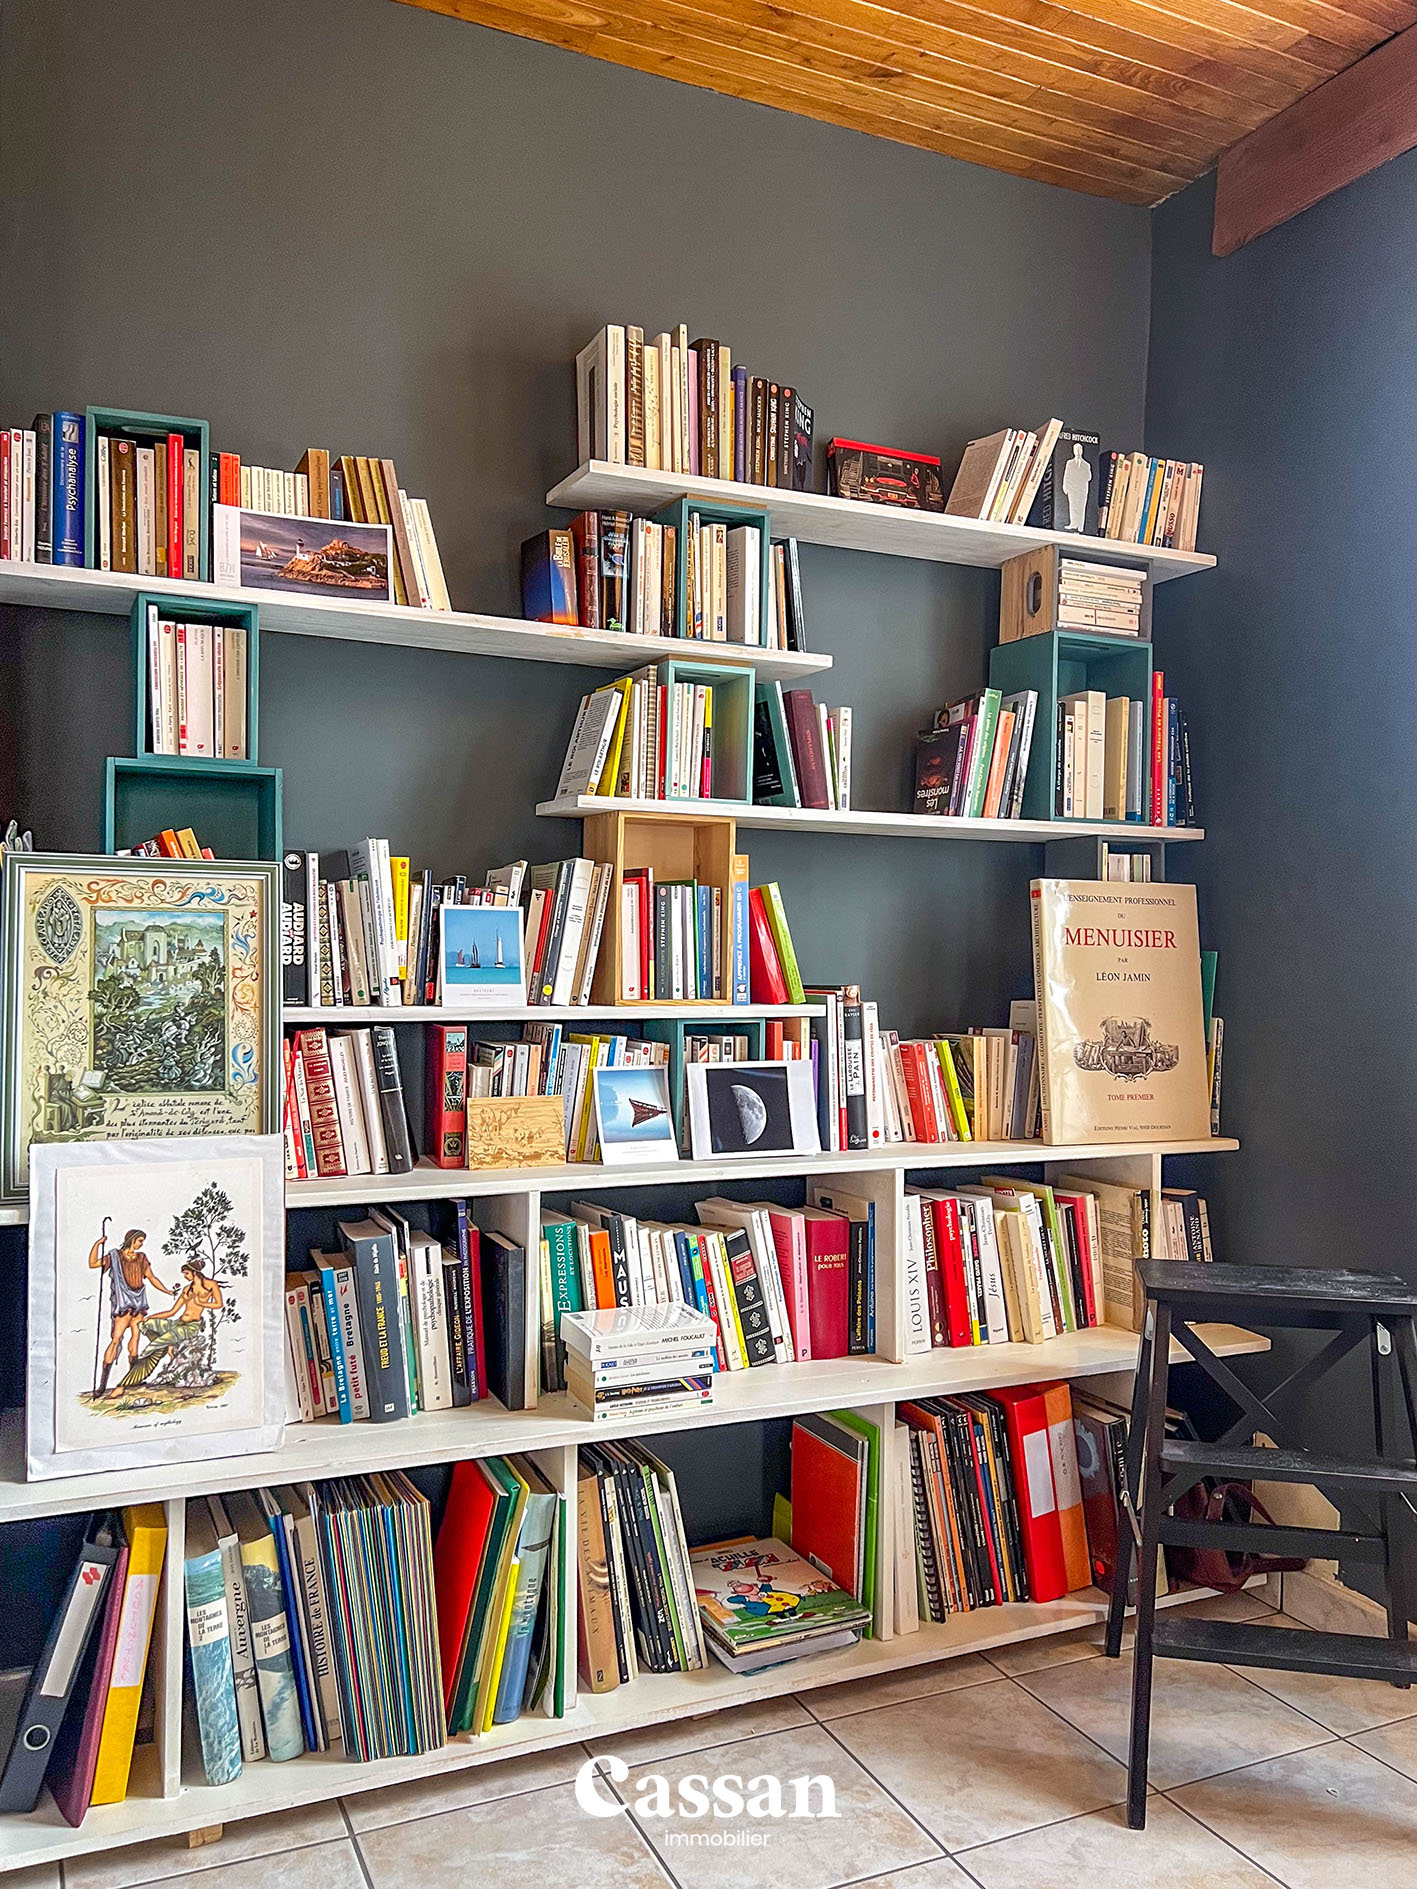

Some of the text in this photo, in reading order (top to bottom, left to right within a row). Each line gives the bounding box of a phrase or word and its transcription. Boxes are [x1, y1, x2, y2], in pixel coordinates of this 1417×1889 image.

[1072, 433, 1099, 445] HITCHCOCK
[66, 448, 77, 511] Psychanalyse
[1105, 479, 1114, 503] STEPHEN
[1166, 513, 1176, 536] MUSSO
[553, 542, 563, 561] BIBLE
[574, 709, 588, 745] ARTHUR
[915, 785, 949, 799] monstres
[1124, 896, 1177, 907] PROFESSIONNEL
[293, 902, 305, 966] AUDIARD
[1064, 927, 1178, 949] MENUISIER
[1096, 971, 1151, 982] LÉON JAMIN
[849, 1083, 854, 1091] LE
[1126, 1093, 1155, 1101] PREMIER
[945, 1200, 956, 1241] psychologie
[1190, 1215, 1199, 1251] ANTOINE
[921, 1204, 937, 1273] Philosopher
[1194, 1217, 1203, 1250] RENAND
[566, 1225, 575, 1276] ET LOCUTIONS
[814, 1253, 847, 1263] LE ROBERT
[980, 1206, 1001, 1299] Jésus Jean-Christian
[555, 1227, 571, 1312] EXPRESSIONS
[613, 1247, 630, 1309] MAUS
[906, 1258, 918, 1284] XIV
[463, 1266, 473, 1315] L'EXPOSITION
[855, 1279, 863, 1304] Poisons
[426, 1278, 438, 1331] psychopathologie
[908, 1288, 923, 1334] LOUIS
[330, 1315, 338, 1336] terre
[375, 1305, 386, 1331] FRANCE
[453, 1314, 462, 1340] GIDEON
[465, 1315, 472, 1324] DE
[854, 1317, 862, 1342] L'affaire
[378, 1330, 387, 1340] LA
[464, 1323, 475, 1355] PRATIQUE
[661, 1332, 706, 1344] MICHEL FOUCAULT
[343, 1303, 363, 1400] petit futé Bretagne
[379, 1347, 389, 1370] FREUD
[454, 1341, 463, 1375] L'AFFAIRE
[335, 1354, 346, 1392] Bretagne
[339, 1393, 347, 1404] La
[578, 1490, 600, 1636] LA VIE DES ANIMAUX
[709, 1549, 760, 1565] ACHILLE
[190, 1610, 223, 1624] MONTAGNES
[196, 1609, 207, 1617] LES
[231, 1580, 249, 1660] Auvergne
[304, 1555, 329, 1680] HISTOIRE de FRANCE
[206, 1622, 223, 1633] TERRE
[255, 1622, 286, 1639] MONTAGNES
[263, 1634, 287, 1649] LA TERRE
